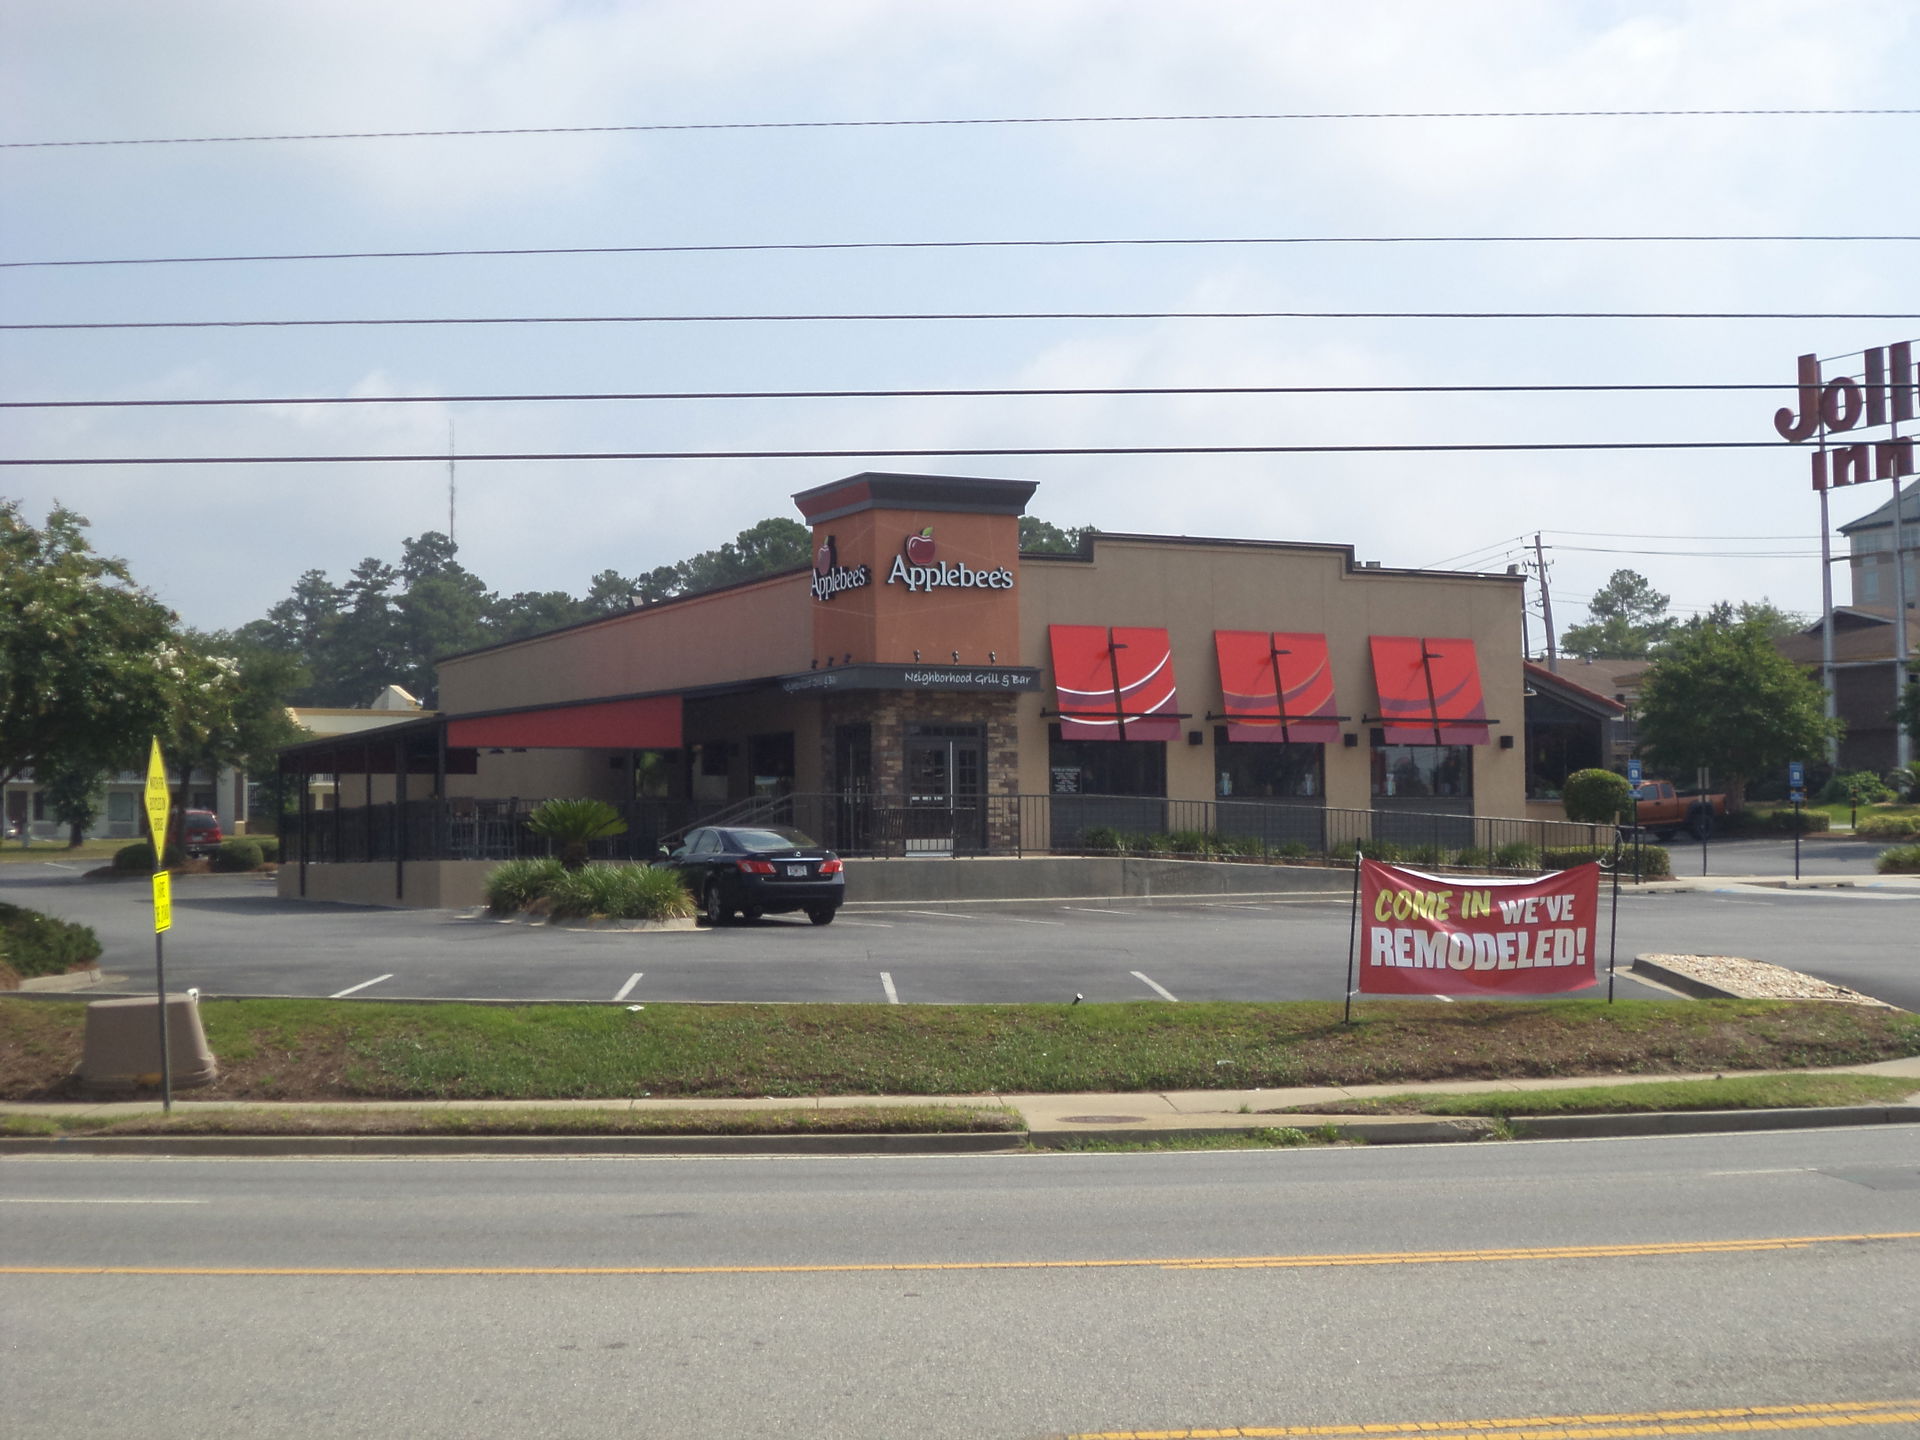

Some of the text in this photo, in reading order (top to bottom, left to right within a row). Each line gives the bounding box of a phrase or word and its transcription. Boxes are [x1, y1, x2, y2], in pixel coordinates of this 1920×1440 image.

[1774, 341, 1920, 442] Joll
[810, 564, 865, 601] Applebee's
[887, 554, 1014, 592] Applebee's
[904, 671, 1031, 686] Neighborhood Grill & Bar
[1375, 889, 1575, 925] COME IN WE'VE
[1370, 927, 1587, 971] REMODELED!
